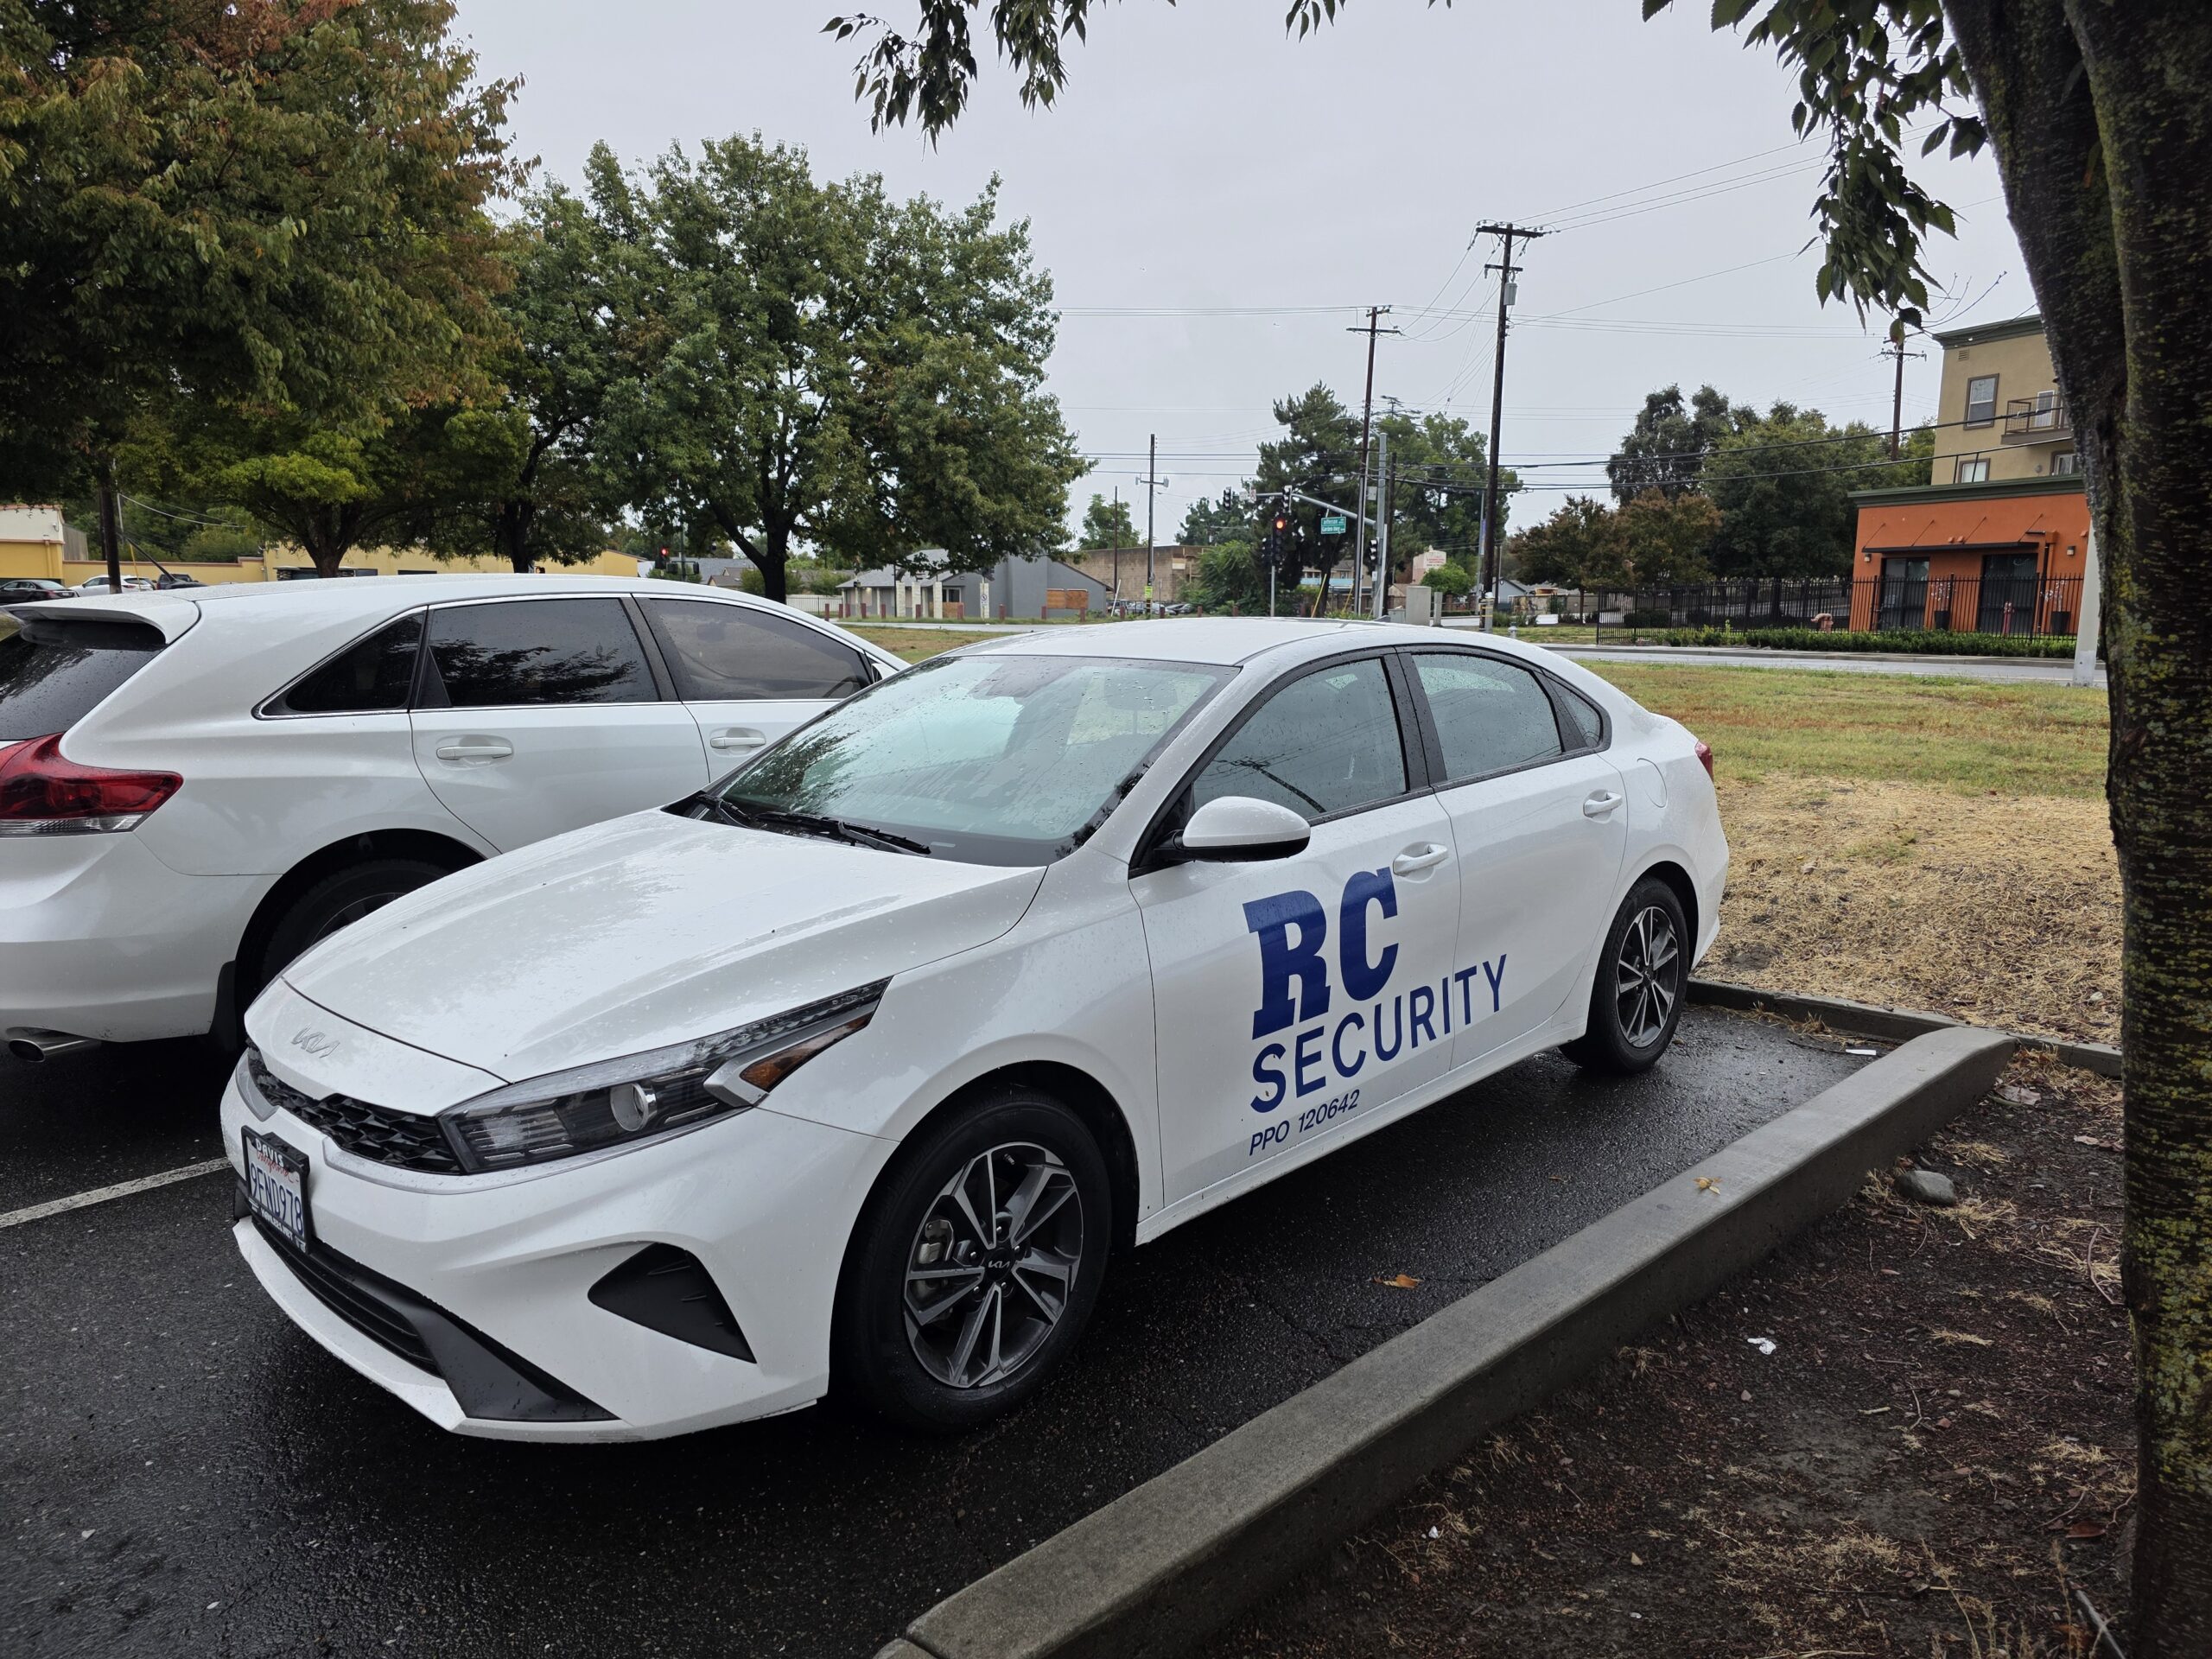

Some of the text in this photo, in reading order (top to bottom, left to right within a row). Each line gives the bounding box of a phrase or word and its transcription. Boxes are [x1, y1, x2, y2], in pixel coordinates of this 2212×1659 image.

[1243, 867, 1399, 1040] RC
[1250, 954, 1507, 1113] SECURITY
[256, 1138, 284, 1167] DAVIS
[1249, 1089, 1360, 1155] PPO 120642
